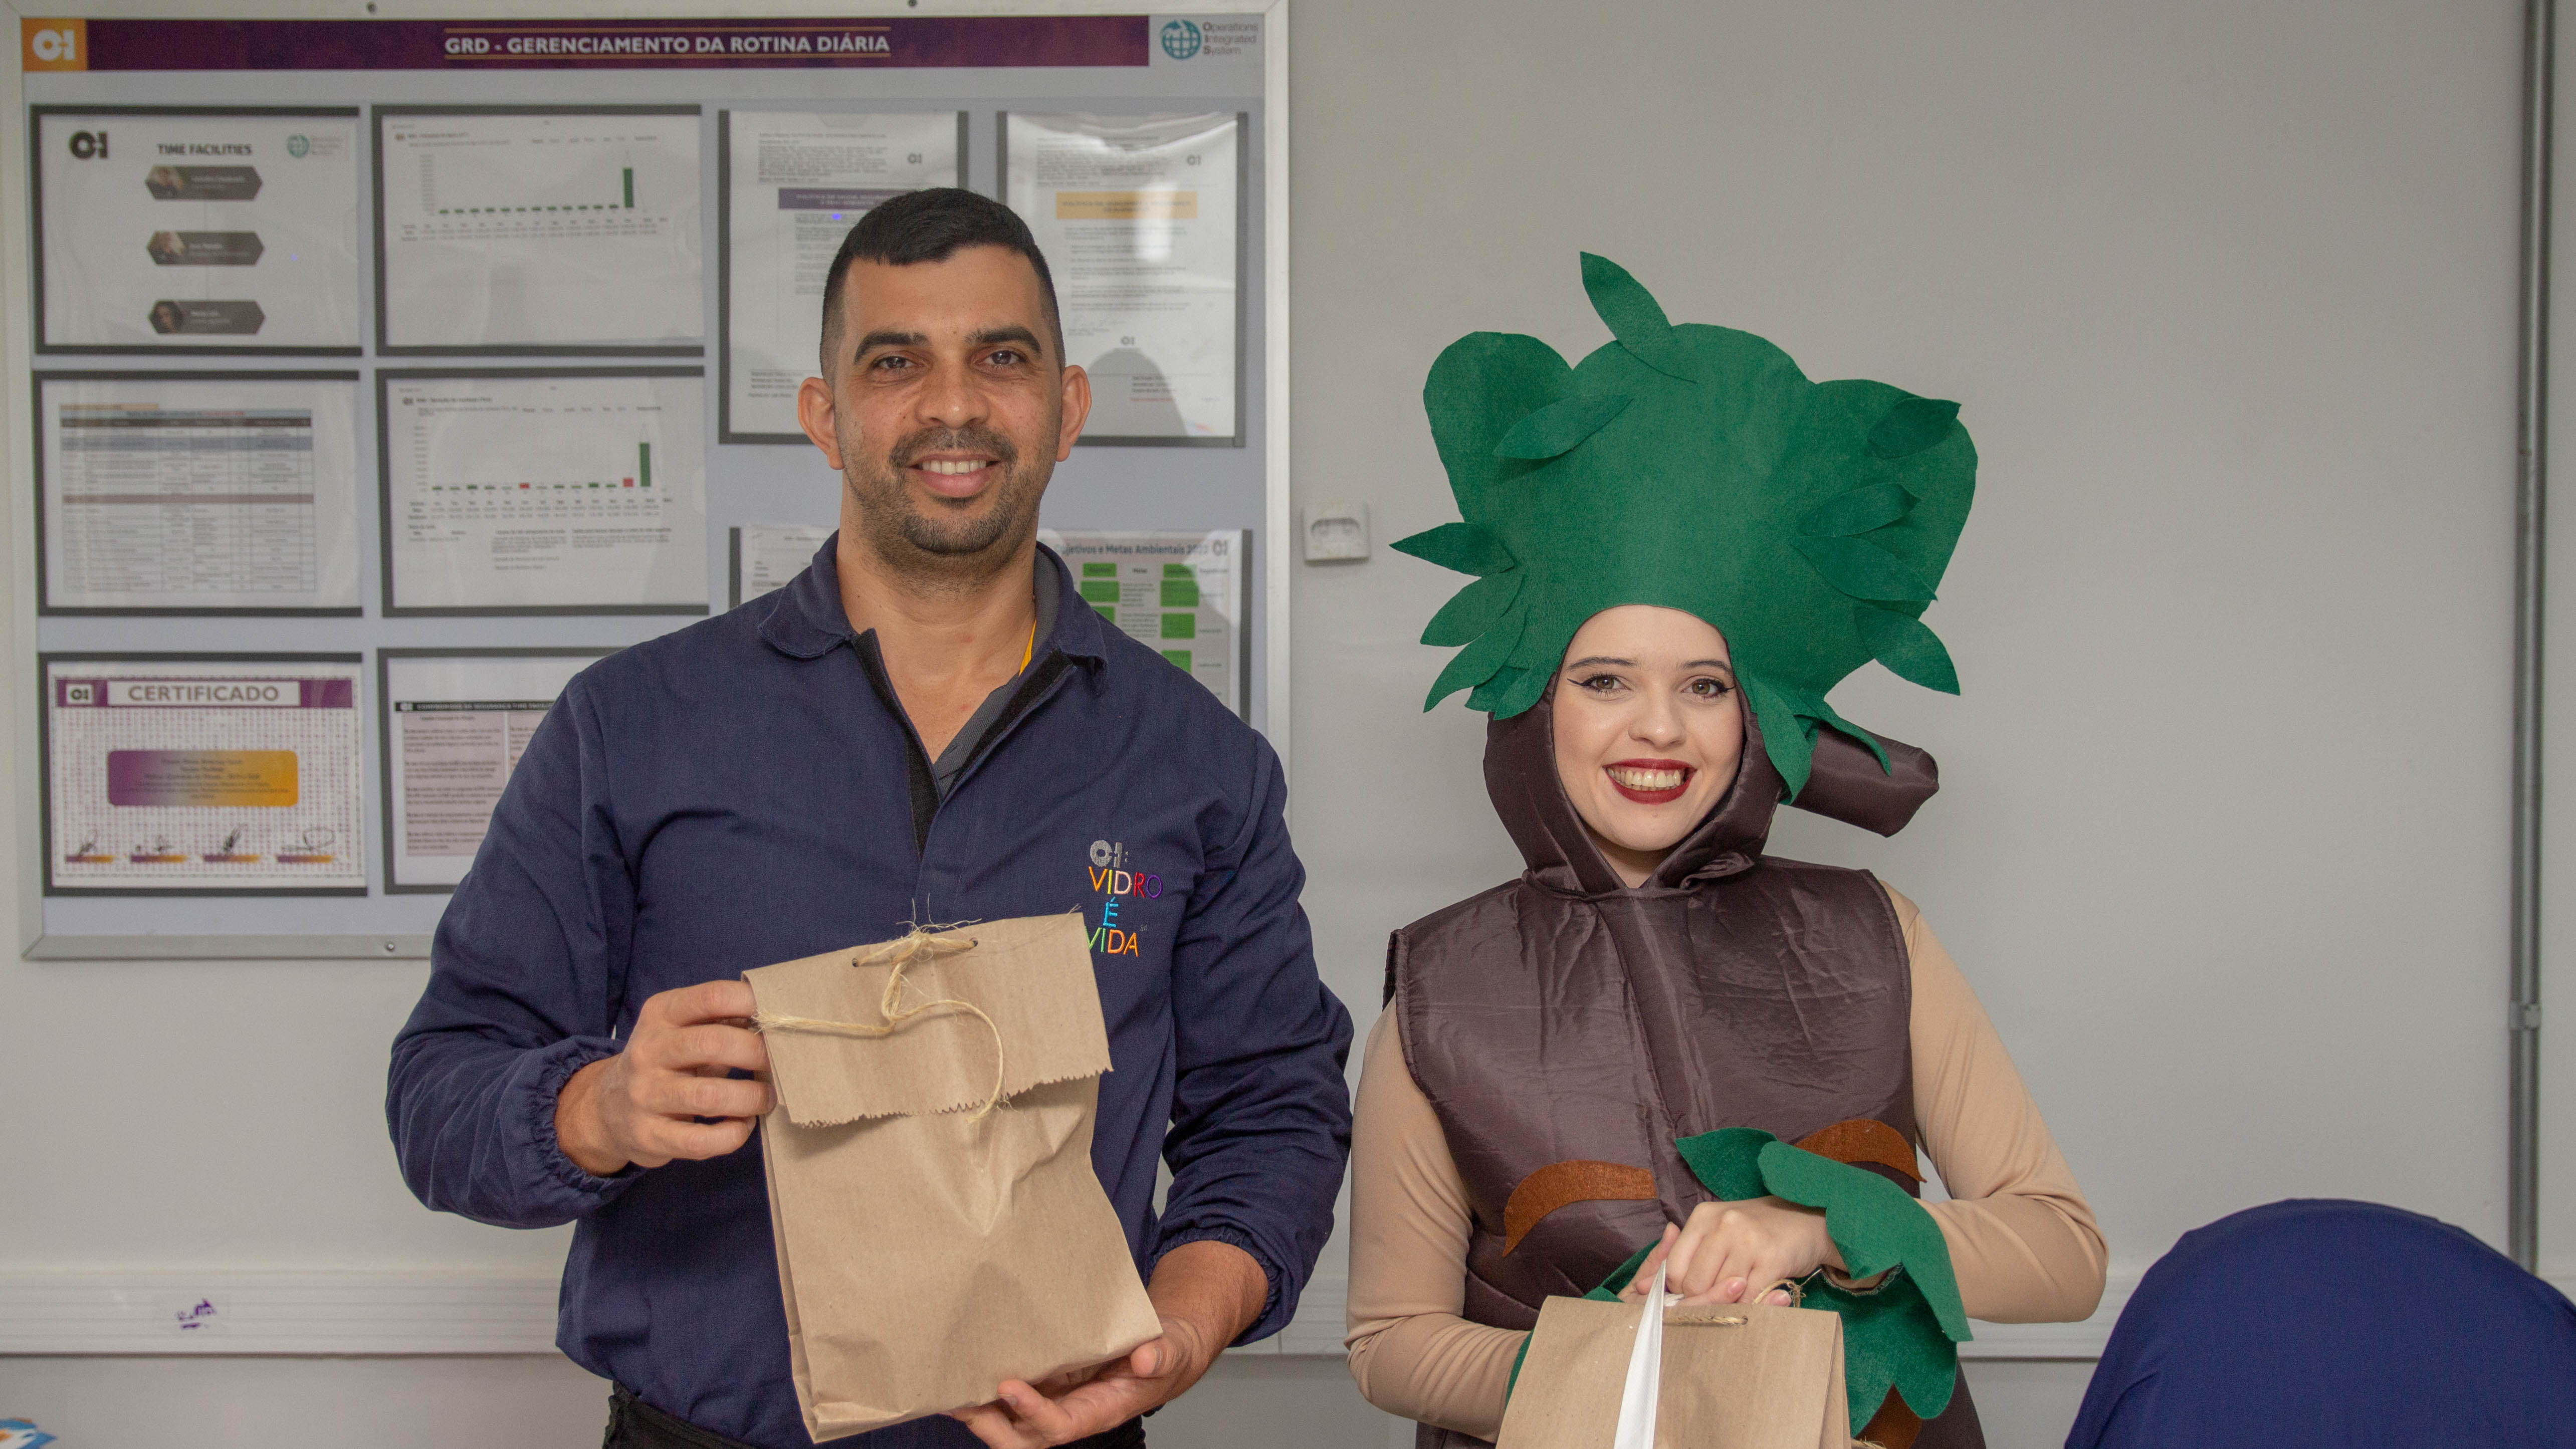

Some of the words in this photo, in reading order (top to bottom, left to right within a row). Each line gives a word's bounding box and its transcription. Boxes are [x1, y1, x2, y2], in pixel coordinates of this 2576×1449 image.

[445, 37, 490, 54] GRD
[507, 37, 690, 54] GERENCIAMENTO
[696, 37, 726, 53] DA
[730, 36, 812, 52] ROTINA
[817, 32, 891, 52] DIÁRIA
[157, 143, 185, 155] TIME
[189, 143, 252, 155] FACILITIES
[129, 685, 279, 701] CERTIFICADO
[1088, 866, 1163, 898] VIDRO
[1103, 896, 1119, 928] É
[1085, 926, 1139, 957] VIDA
